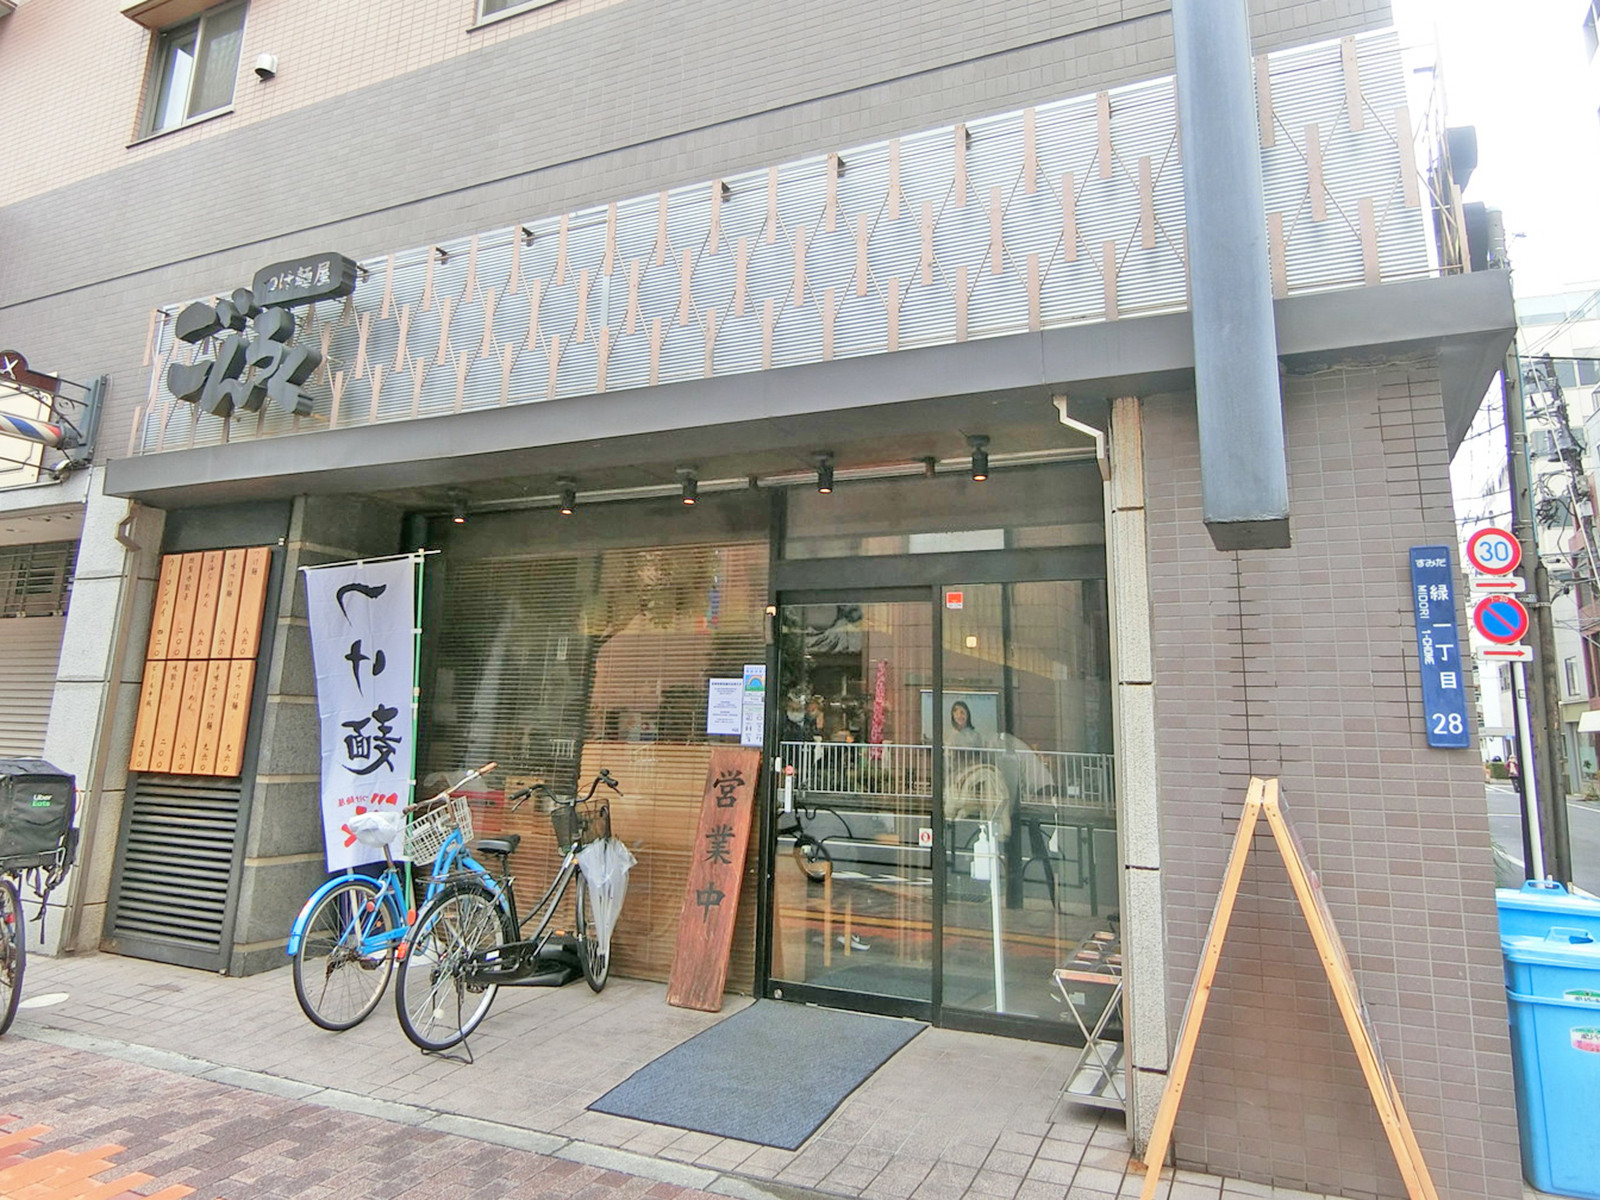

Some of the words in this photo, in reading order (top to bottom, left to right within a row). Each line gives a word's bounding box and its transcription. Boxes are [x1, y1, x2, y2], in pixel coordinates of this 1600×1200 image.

[268, 260, 331, 292] つけ麺屋
[1415, 558, 1447, 568] すみだ
[1479, 541, 1509, 562] 30
[1417, 585, 1430, 619] MIDORI
[1421, 630, 1435, 665] 1-CHOME
[1430, 584, 1458, 689] 緑一丁目
[1432, 713, 1463, 734] 28
[695, 770, 745, 923] 営業中
